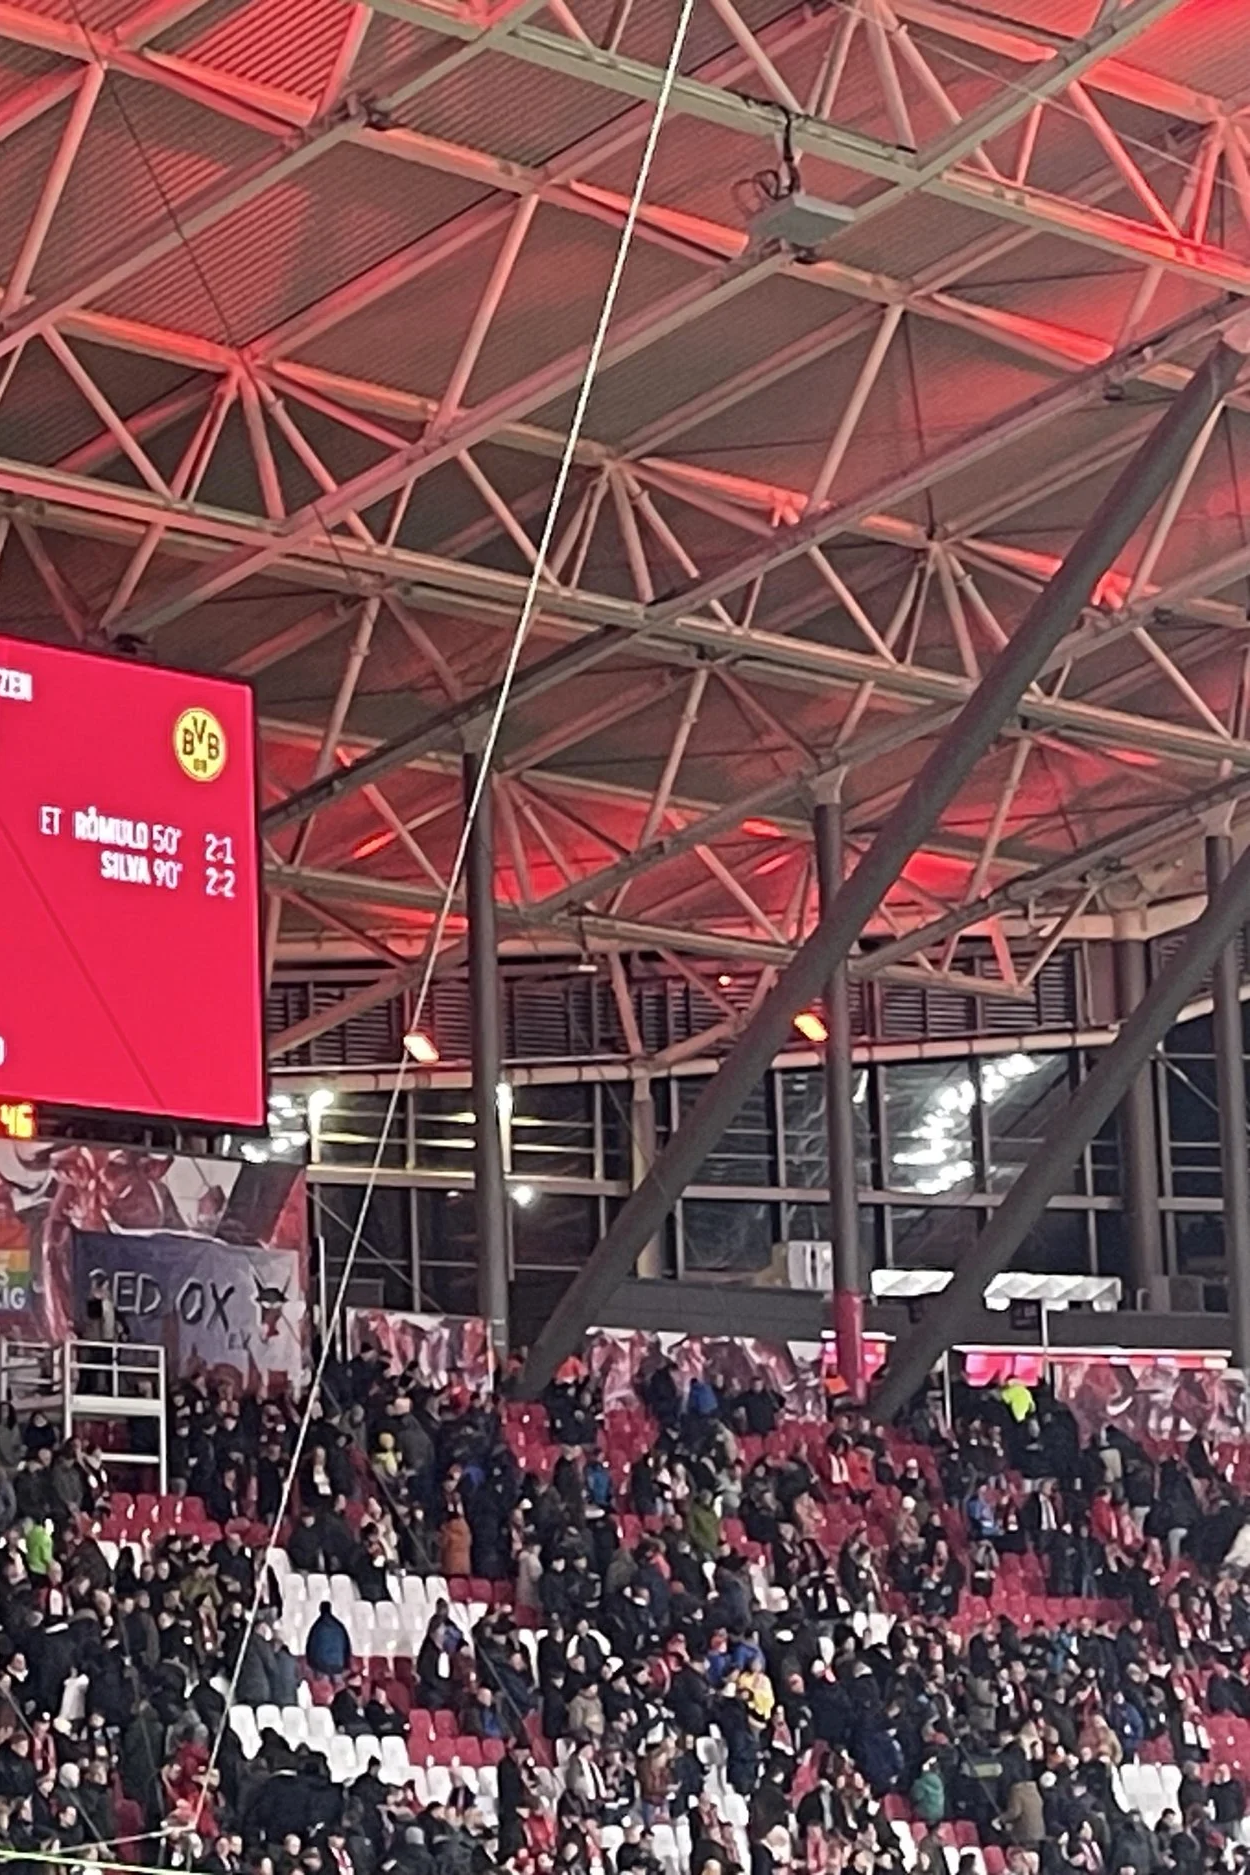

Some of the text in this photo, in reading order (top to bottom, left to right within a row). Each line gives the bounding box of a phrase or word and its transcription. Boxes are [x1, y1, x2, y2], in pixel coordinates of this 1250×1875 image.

[182, 715, 220, 761] BVB
[39, 805, 63, 836] ET
[204, 833, 236, 865] 2:1
[100, 850, 152, 886] SILVA
[204, 866, 236, 899] 2:2
[90, 1267, 236, 1332] ED OX
